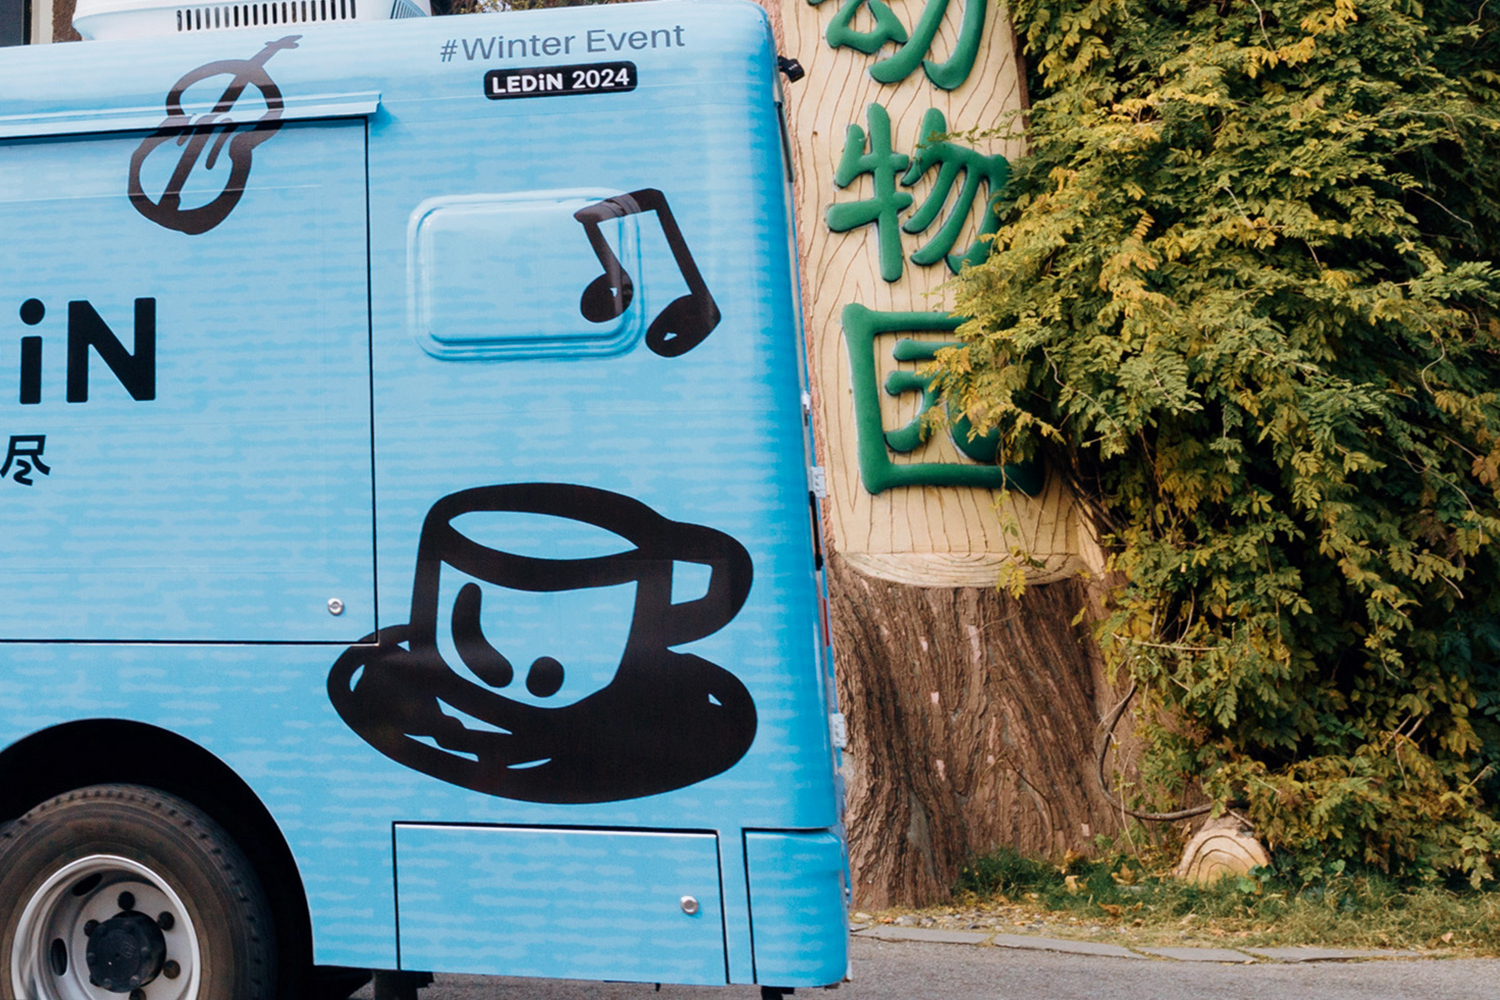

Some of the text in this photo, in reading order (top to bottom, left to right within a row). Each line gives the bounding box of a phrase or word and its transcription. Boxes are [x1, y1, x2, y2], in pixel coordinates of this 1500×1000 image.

[440, 25, 685, 62] #Winter Event
[492, 68, 630, 94] LEDiN 2024
